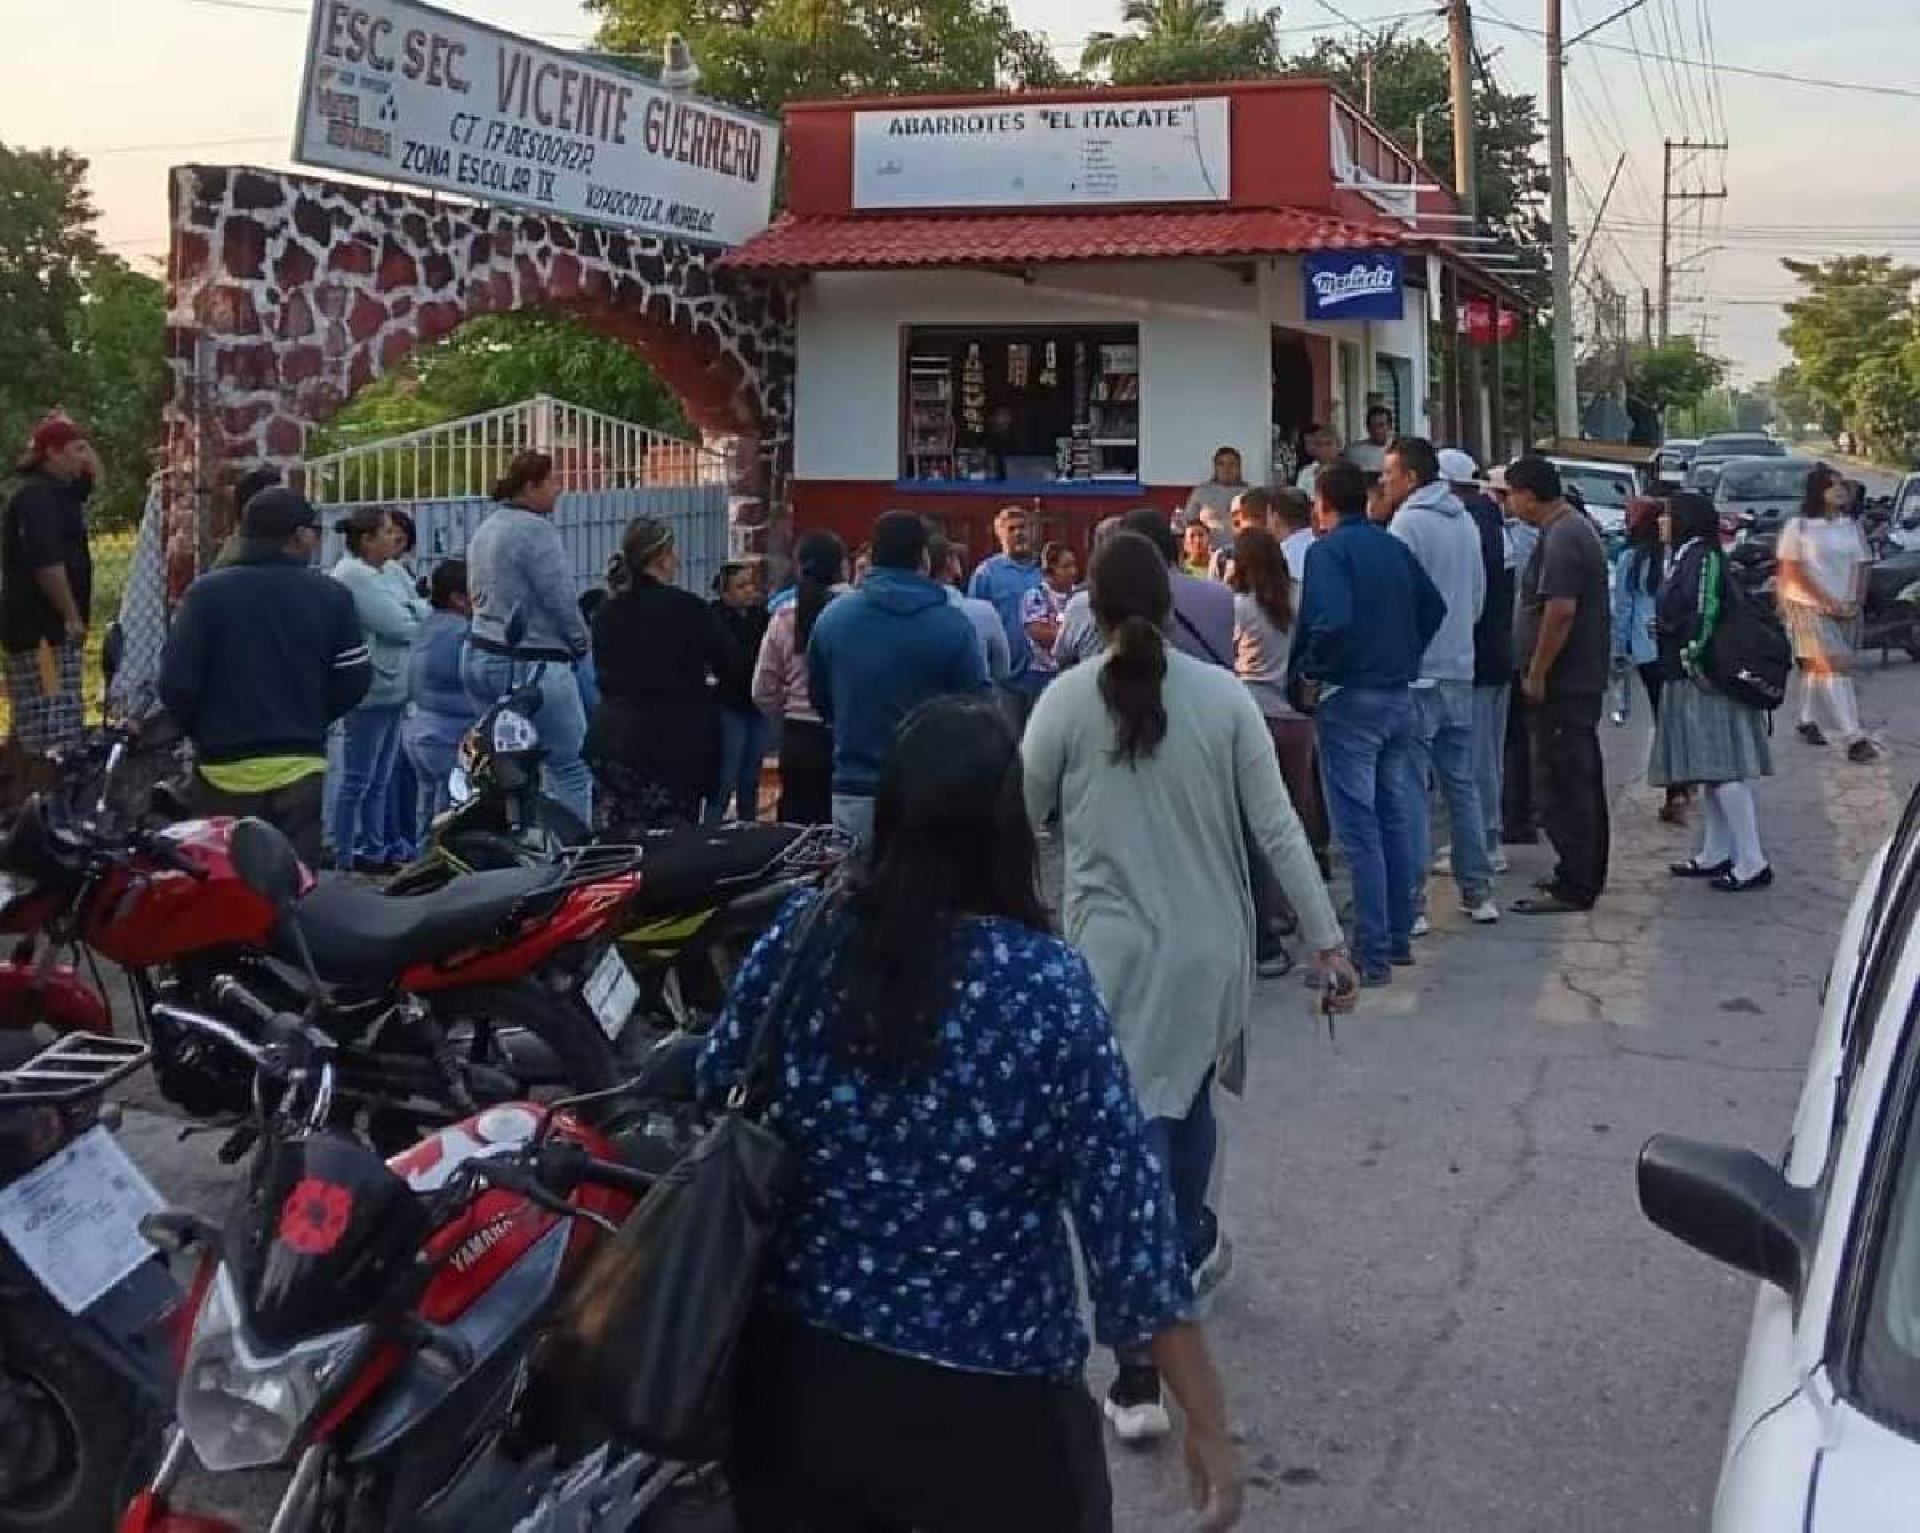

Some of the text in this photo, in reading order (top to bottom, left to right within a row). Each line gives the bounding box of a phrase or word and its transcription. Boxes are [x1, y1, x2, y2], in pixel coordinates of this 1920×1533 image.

[498, 47, 632, 145] VICENTE
[644, 97, 762, 183] GUERRERO
[889, 111, 1025, 135] ABARROTES
[401, 140, 449, 177] ZONA
[456, 153, 531, 194] ESCOLAR
